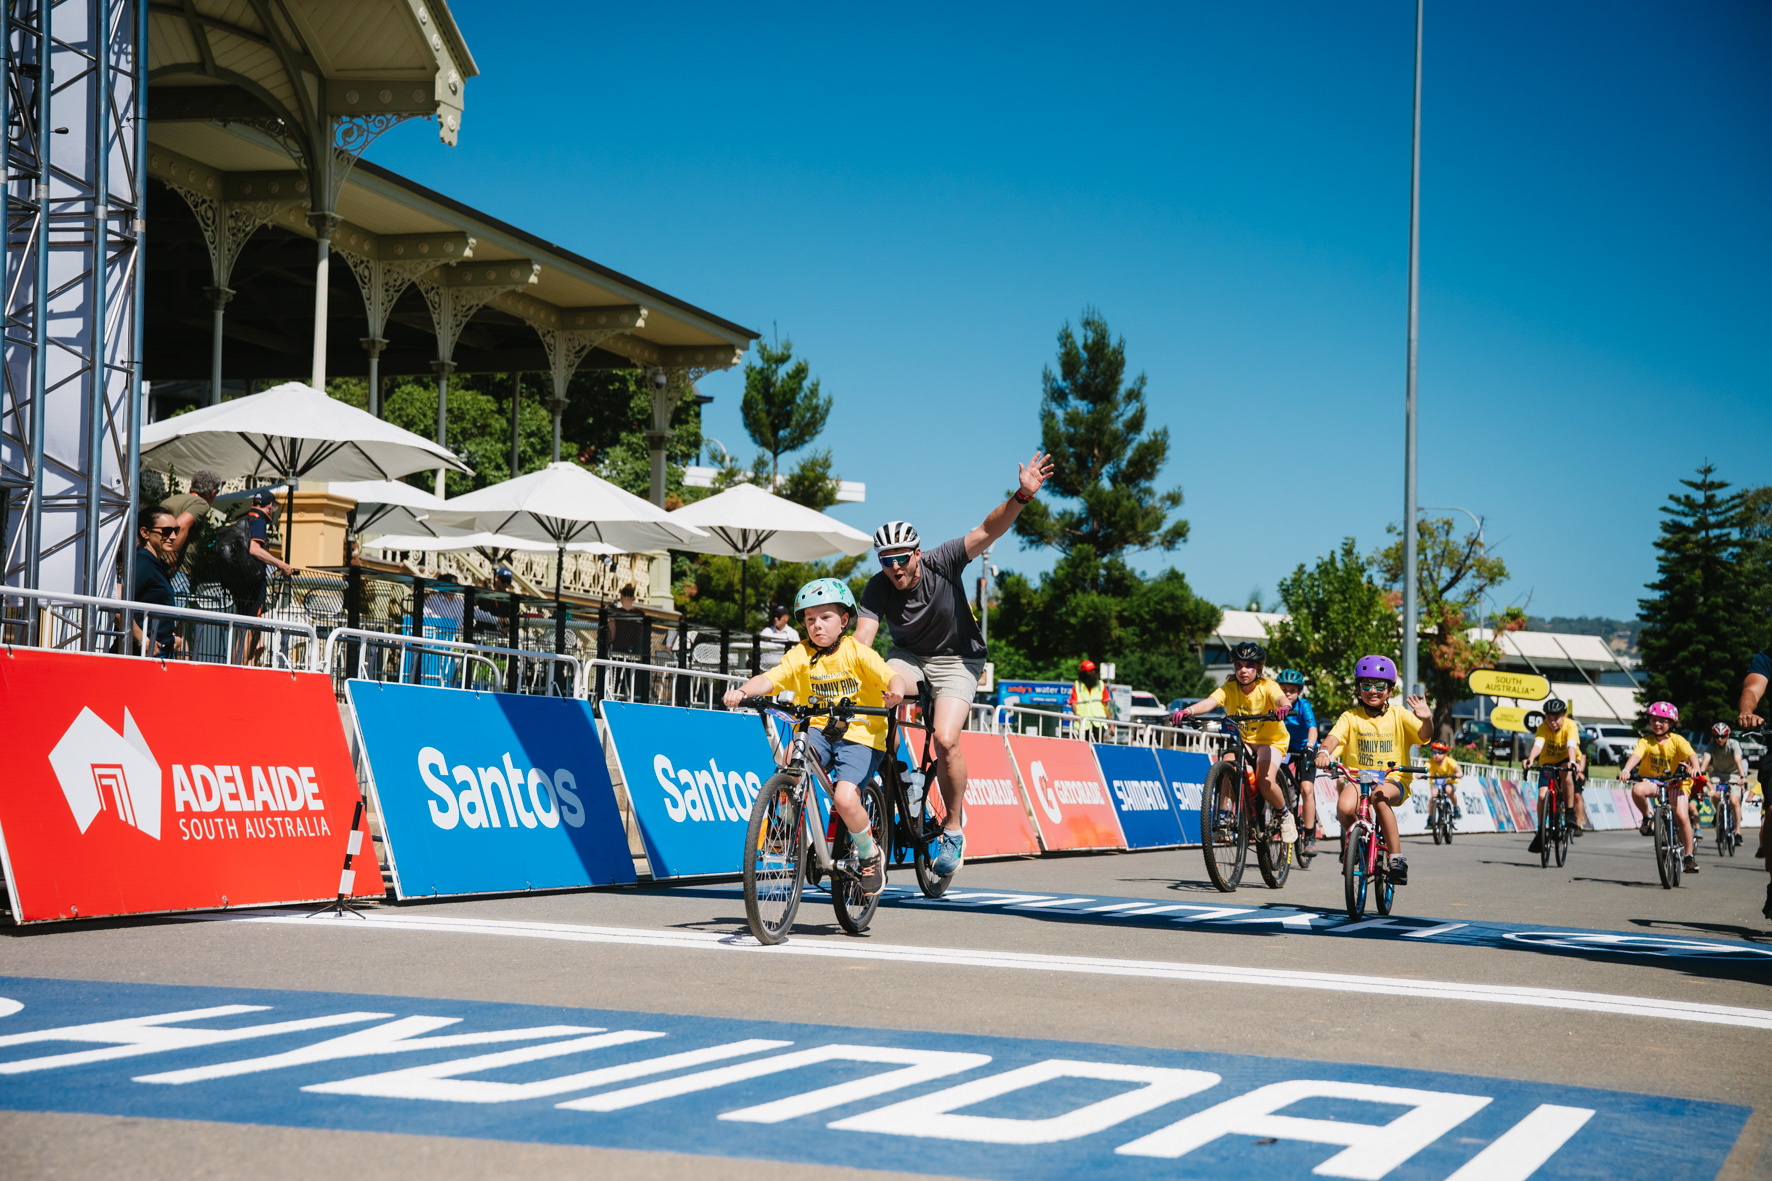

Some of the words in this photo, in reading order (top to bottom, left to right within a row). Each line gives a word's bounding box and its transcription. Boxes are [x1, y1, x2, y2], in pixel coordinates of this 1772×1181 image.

[811, 681, 840, 697] FAMILY
[1034, 686, 1059, 694] water
[1495, 676, 1522, 685] SOUTH
[1528, 715, 1544, 728] 50
[1358, 739, 1379, 753] FAMILY
[1380, 740, 1394, 753] RIDE
[1358, 752, 1374, 767] 2026
[172, 764, 325, 812] ADELAIDE
[417, 746, 586, 830] Santos
[653, 753, 763, 823] Santos
[963, 778, 1019, 806] GATORADE
[1053, 780, 1106, 806] GATORADE
[1112, 780, 1169, 812] SHIMANO
[179, 818, 240, 840] SOUTH
[245, 816, 331, 838] AUSTRALIA
[0, 1004, 1595, 1181] HYUNDAI
